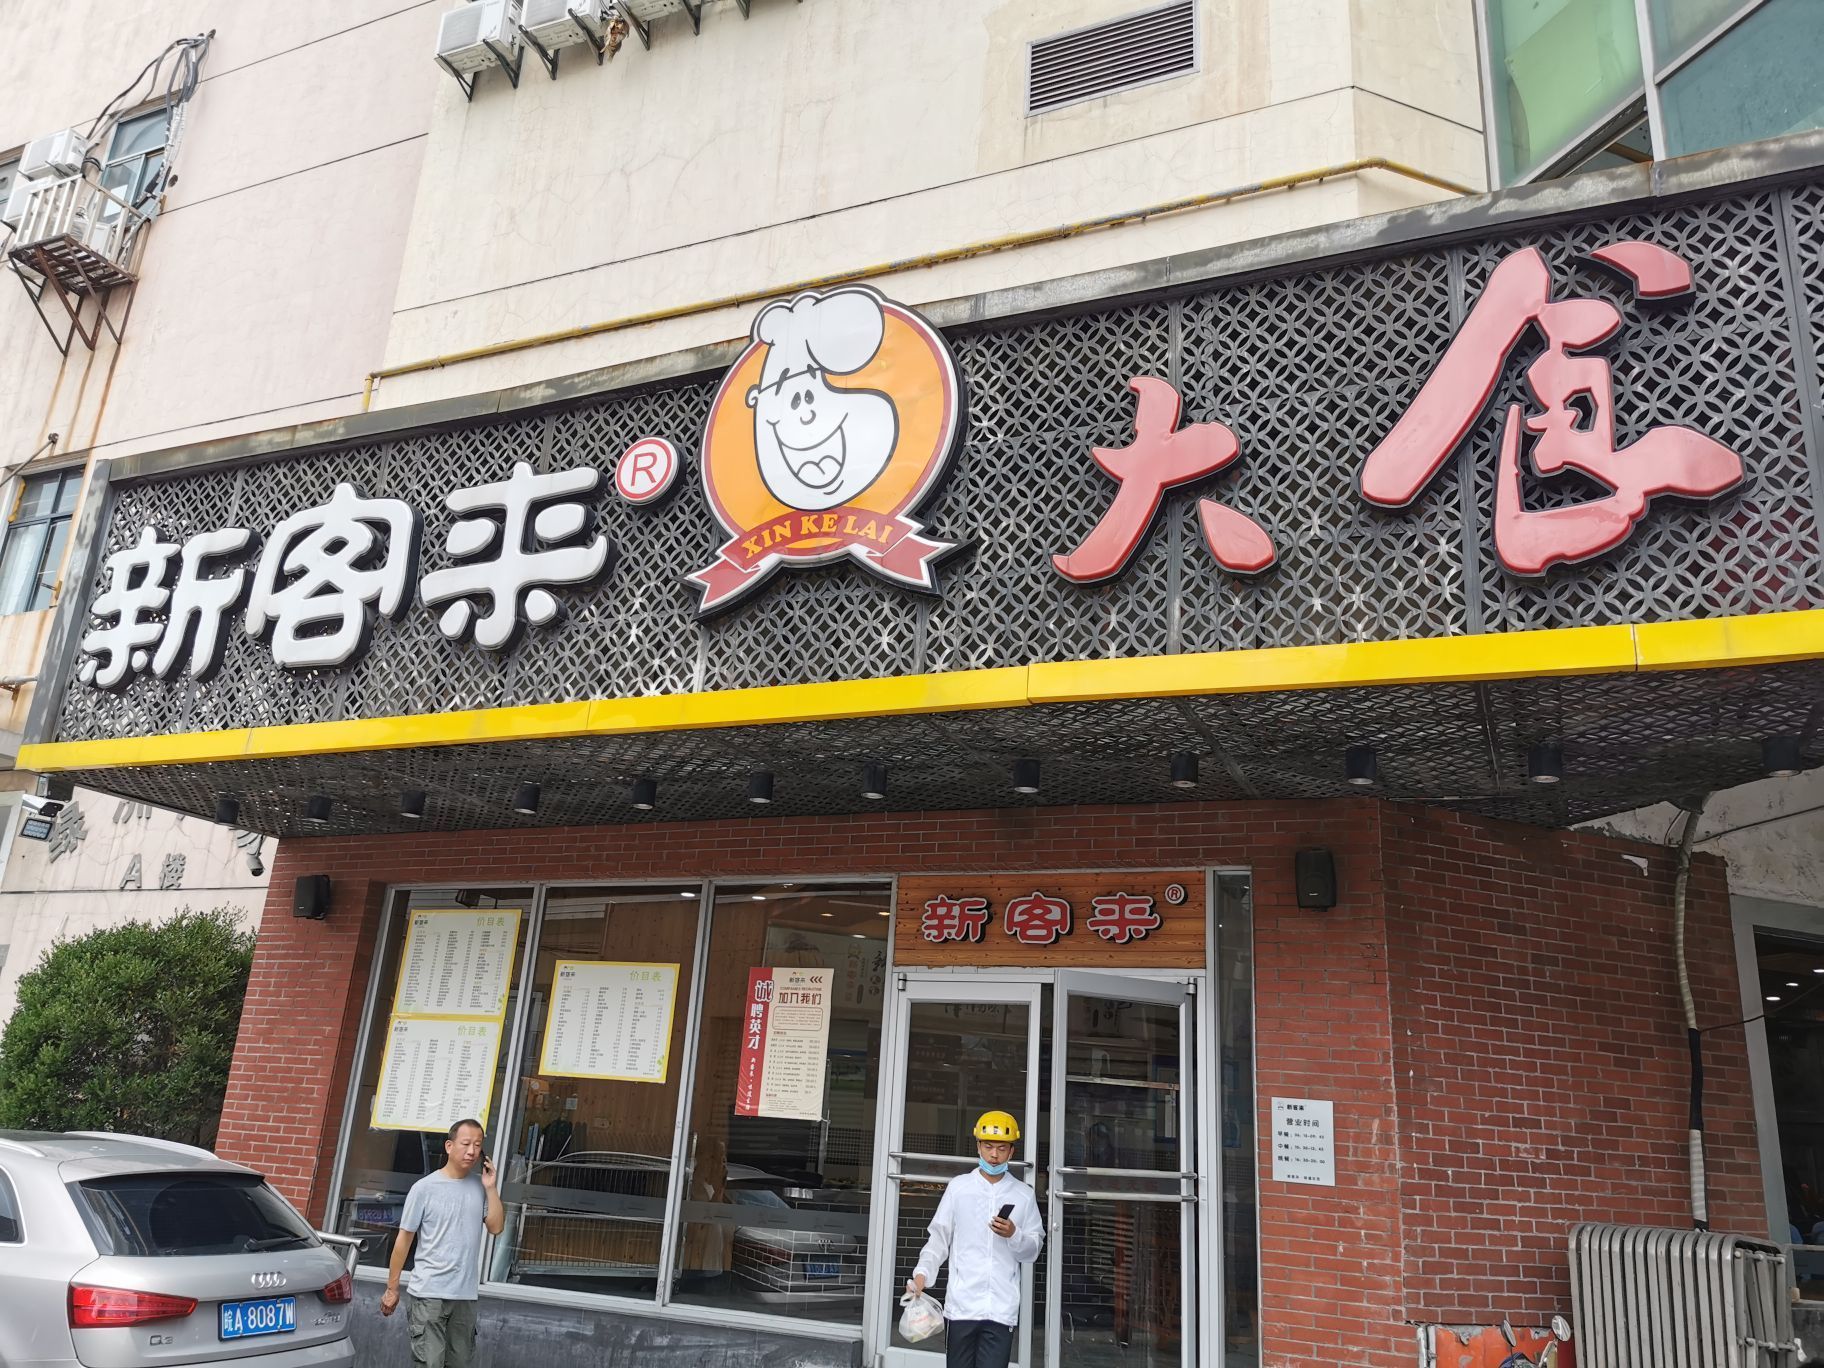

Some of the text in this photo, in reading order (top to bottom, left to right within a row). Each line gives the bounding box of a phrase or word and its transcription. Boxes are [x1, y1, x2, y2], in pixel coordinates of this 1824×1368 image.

[742, 513, 895, 558] XIN KE LAI
[78, 461, 611, 694] 新客来
[477, 916, 506, 928] 价目表
[921, 891, 1161, 944] 新客来
[629, 969, 663, 982] 价目表
[778, 992, 822, 1006] 加入我们
[748, 980, 774, 1049] 诚聘英才
[457, 1025, 488, 1037] 价目表
[1286, 1117, 1320, 1128] 营业时间
[149, 1334, 175, 1346] Q3
